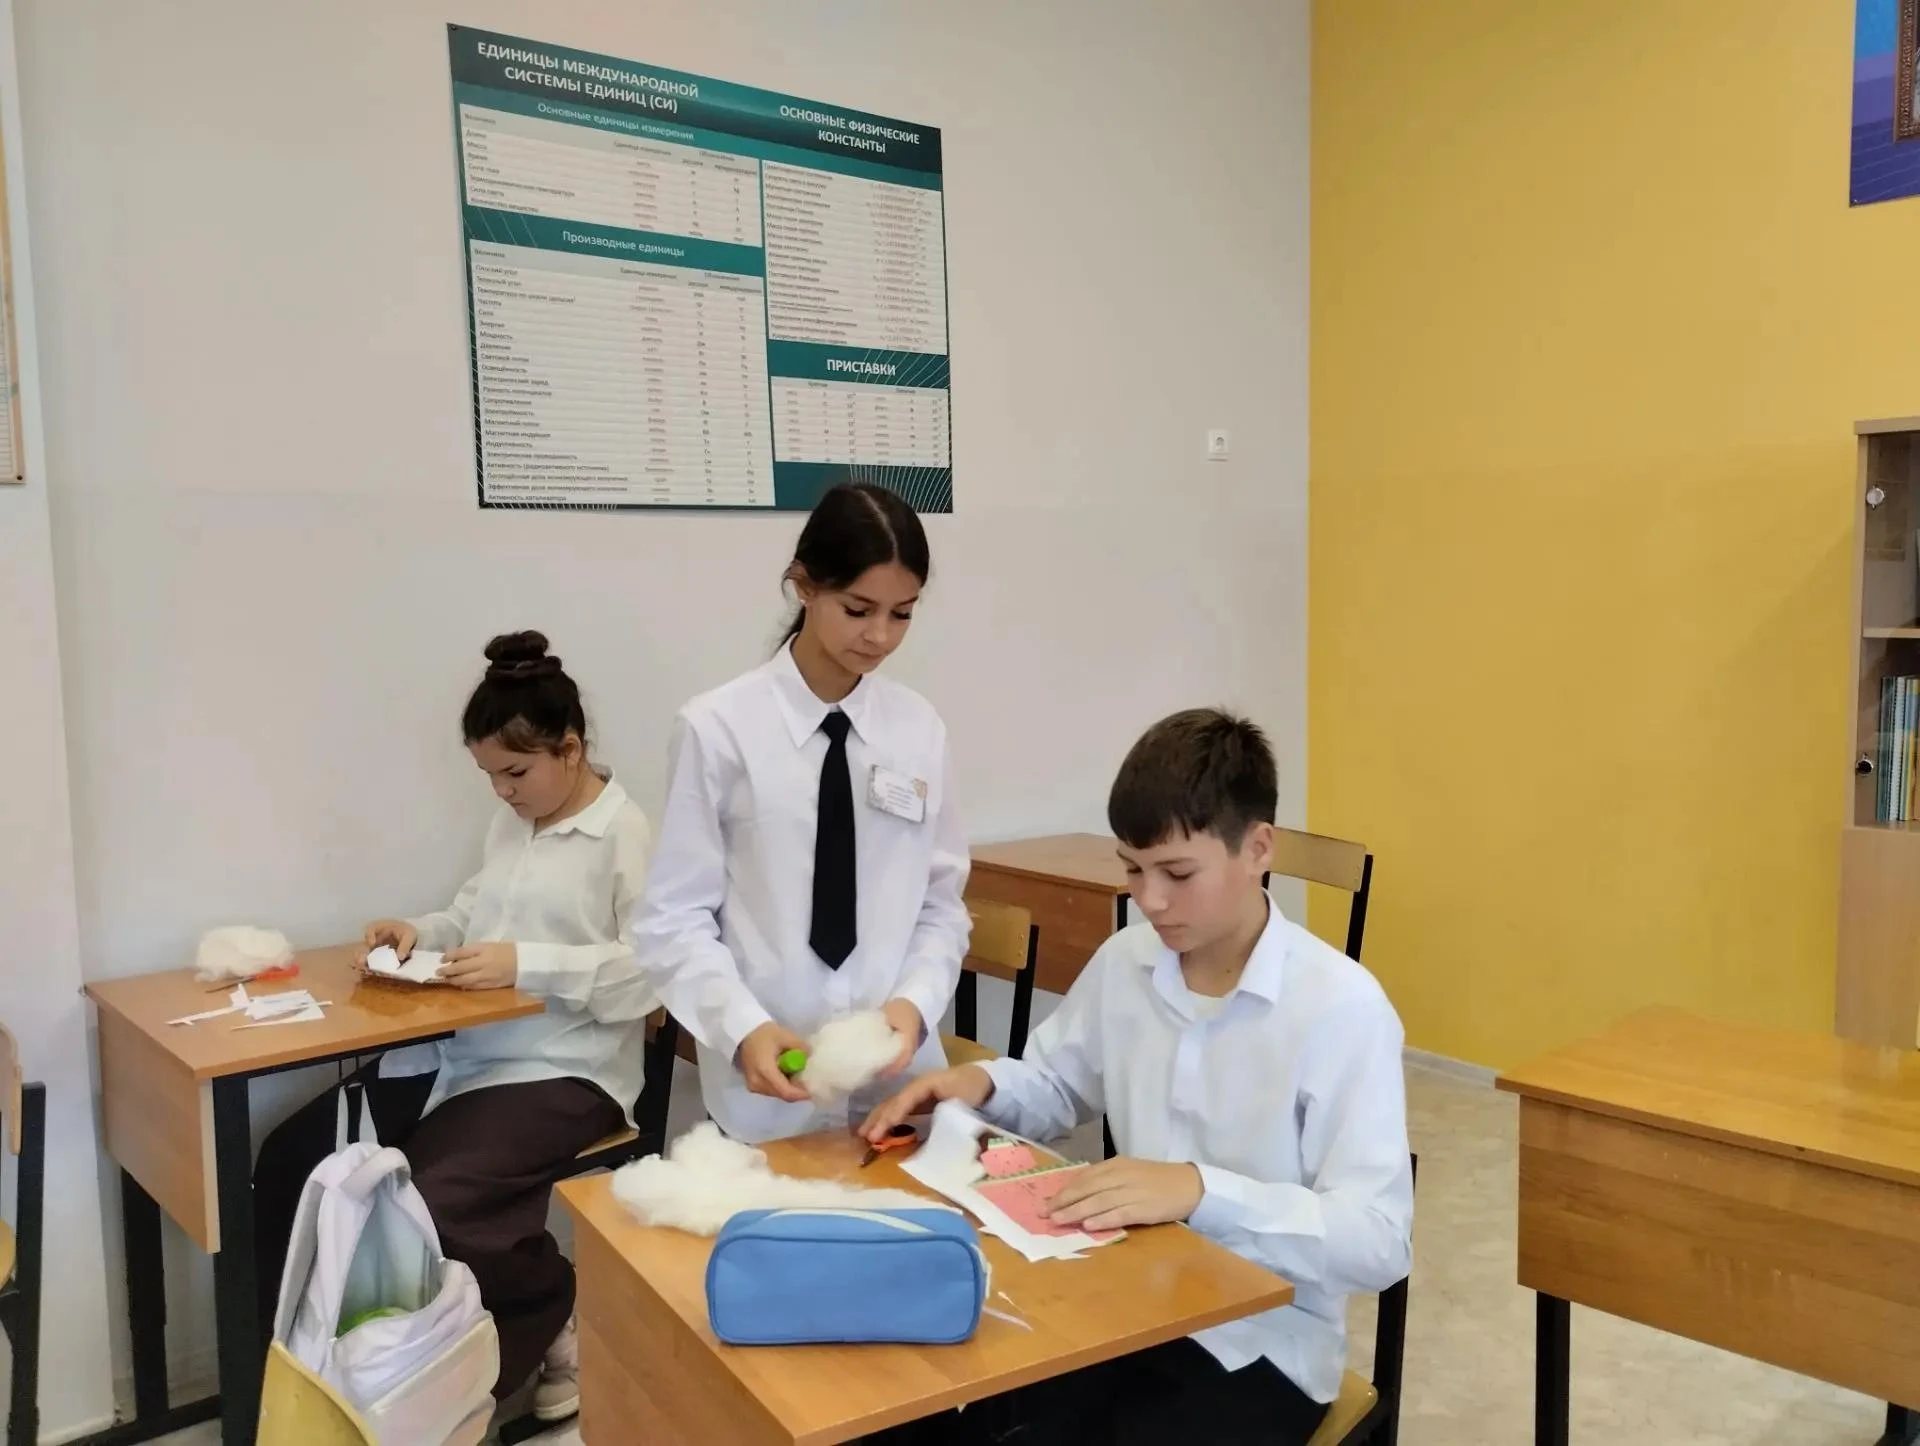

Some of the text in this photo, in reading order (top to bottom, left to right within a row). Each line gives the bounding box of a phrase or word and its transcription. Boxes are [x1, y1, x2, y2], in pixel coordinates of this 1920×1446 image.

[477, 42, 699, 98] ЕДИНИЦЫ МЕЖДУНАРОДНОЙ
[505, 66, 678, 114] СИСТЕМЫ ЕДИНИЦ (СИ)
[538, 103, 695, 141] Основные единицы измерения
[780, 105, 920, 145] ОСНОВНЫЕ ФИЗИЧЕСКИЕ
[818, 130, 886, 153] КОНСТАНТЫ
[563, 230, 685, 257] Производные единицы
[826, 359, 897, 376] ПРИСТАВКИ
